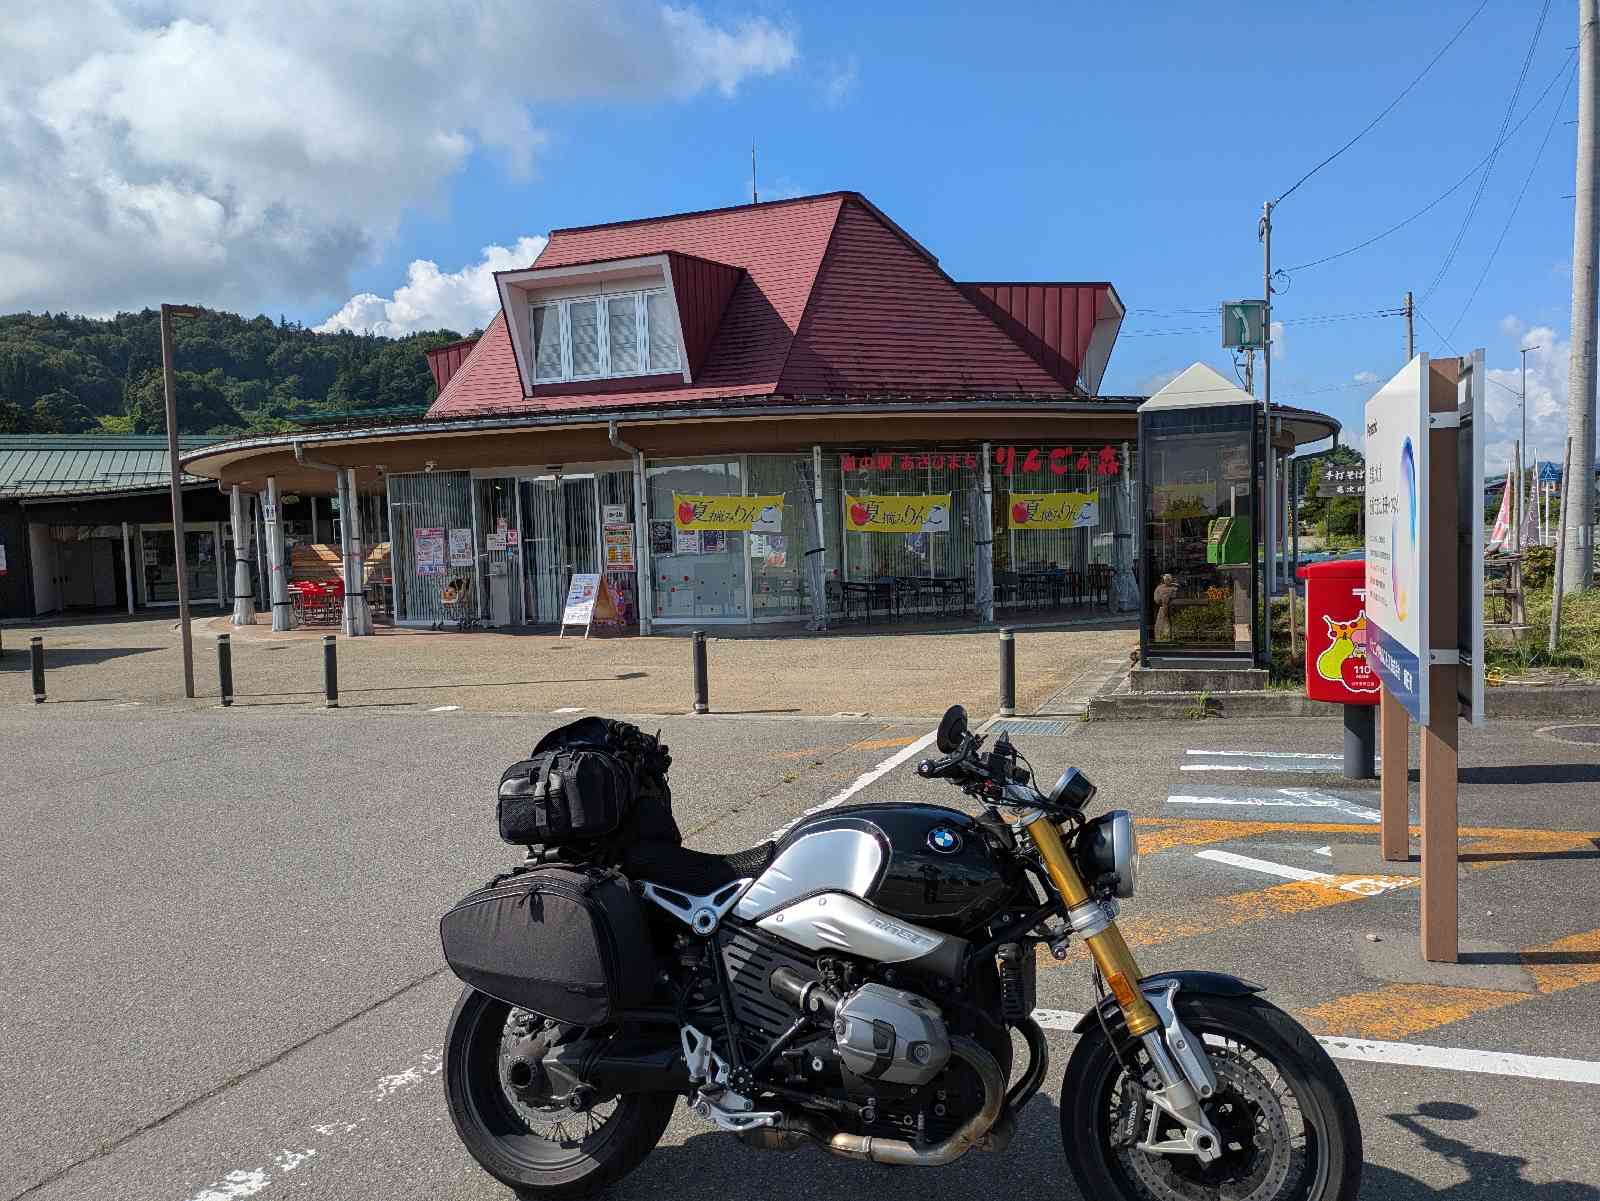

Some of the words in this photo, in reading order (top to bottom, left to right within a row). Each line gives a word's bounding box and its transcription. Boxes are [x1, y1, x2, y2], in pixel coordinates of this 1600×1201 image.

[994, 444, 1120, 476] りんごの森
